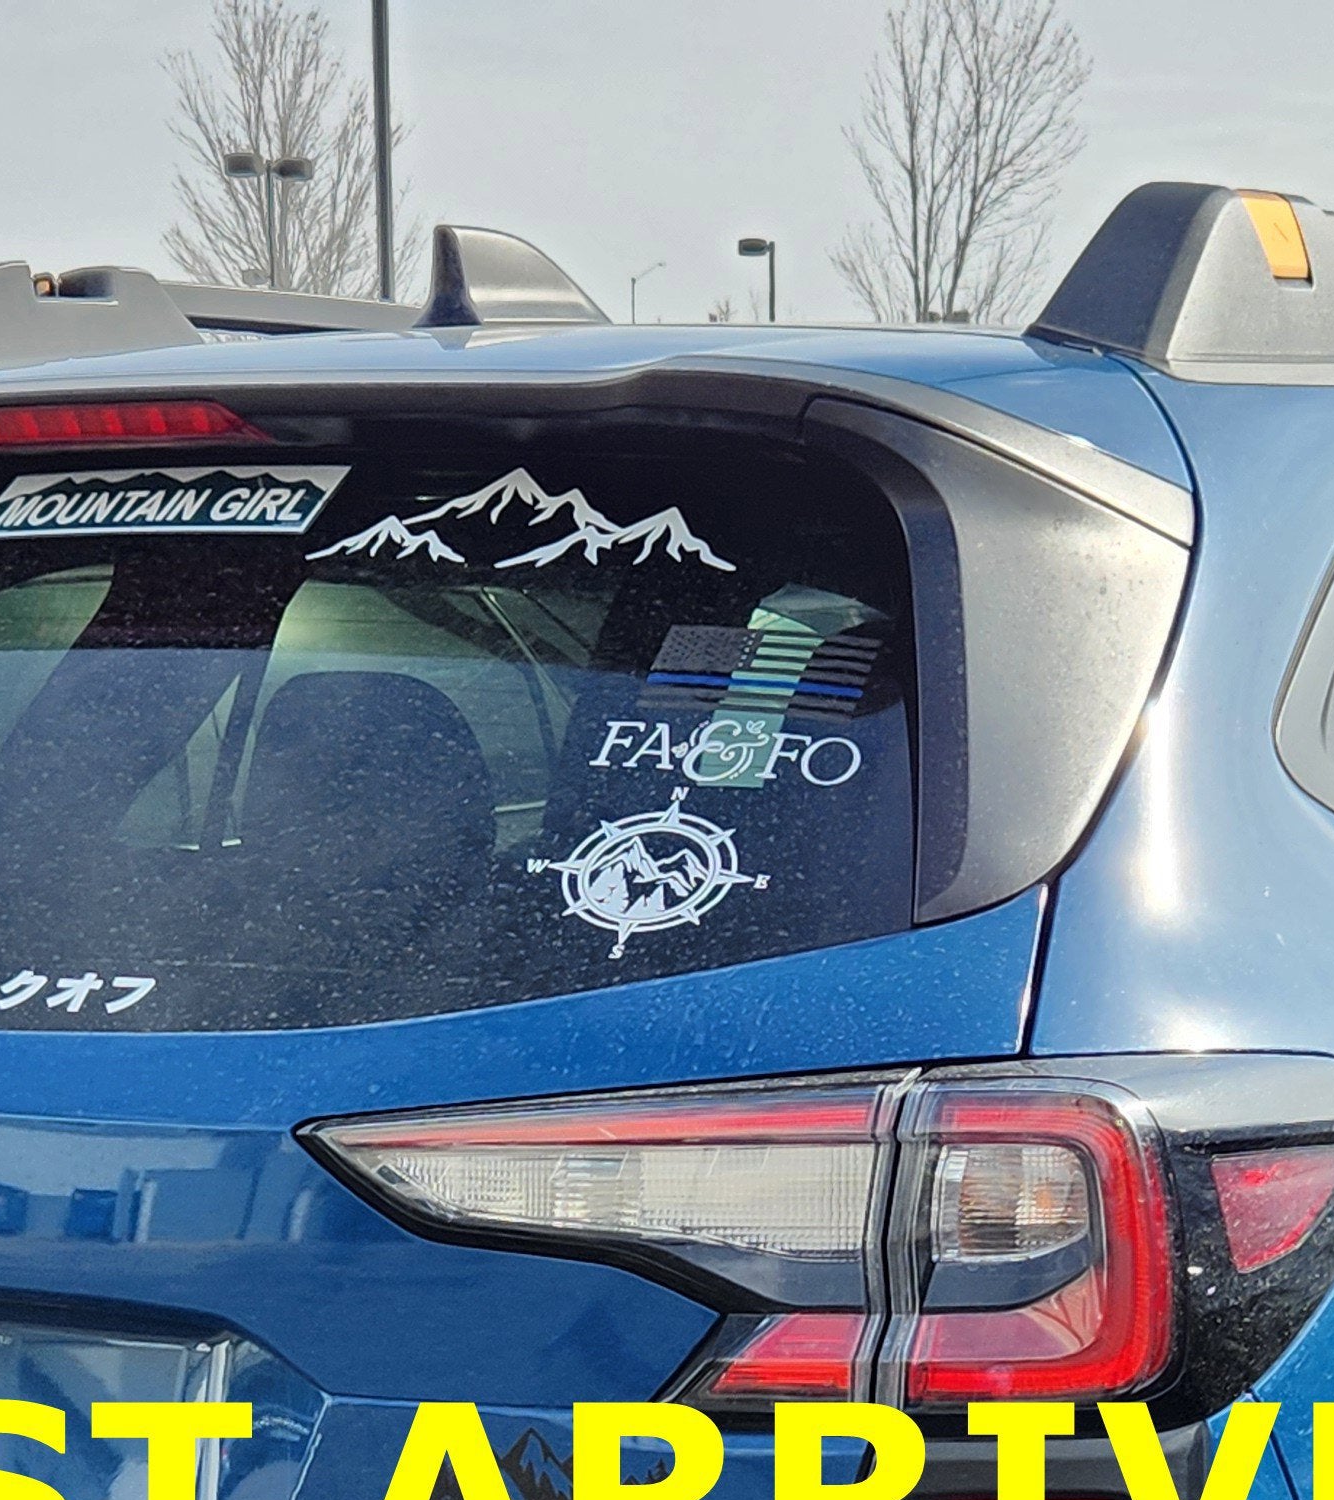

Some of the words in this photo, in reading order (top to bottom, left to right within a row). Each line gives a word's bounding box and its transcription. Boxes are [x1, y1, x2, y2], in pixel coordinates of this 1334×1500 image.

[210, 487, 308, 522] GIRL
[670, 786, 689, 801] N
[526, 858, 551, 873] W
[753, 874, 771, 888] E
[607, 943, 626, 959] S
